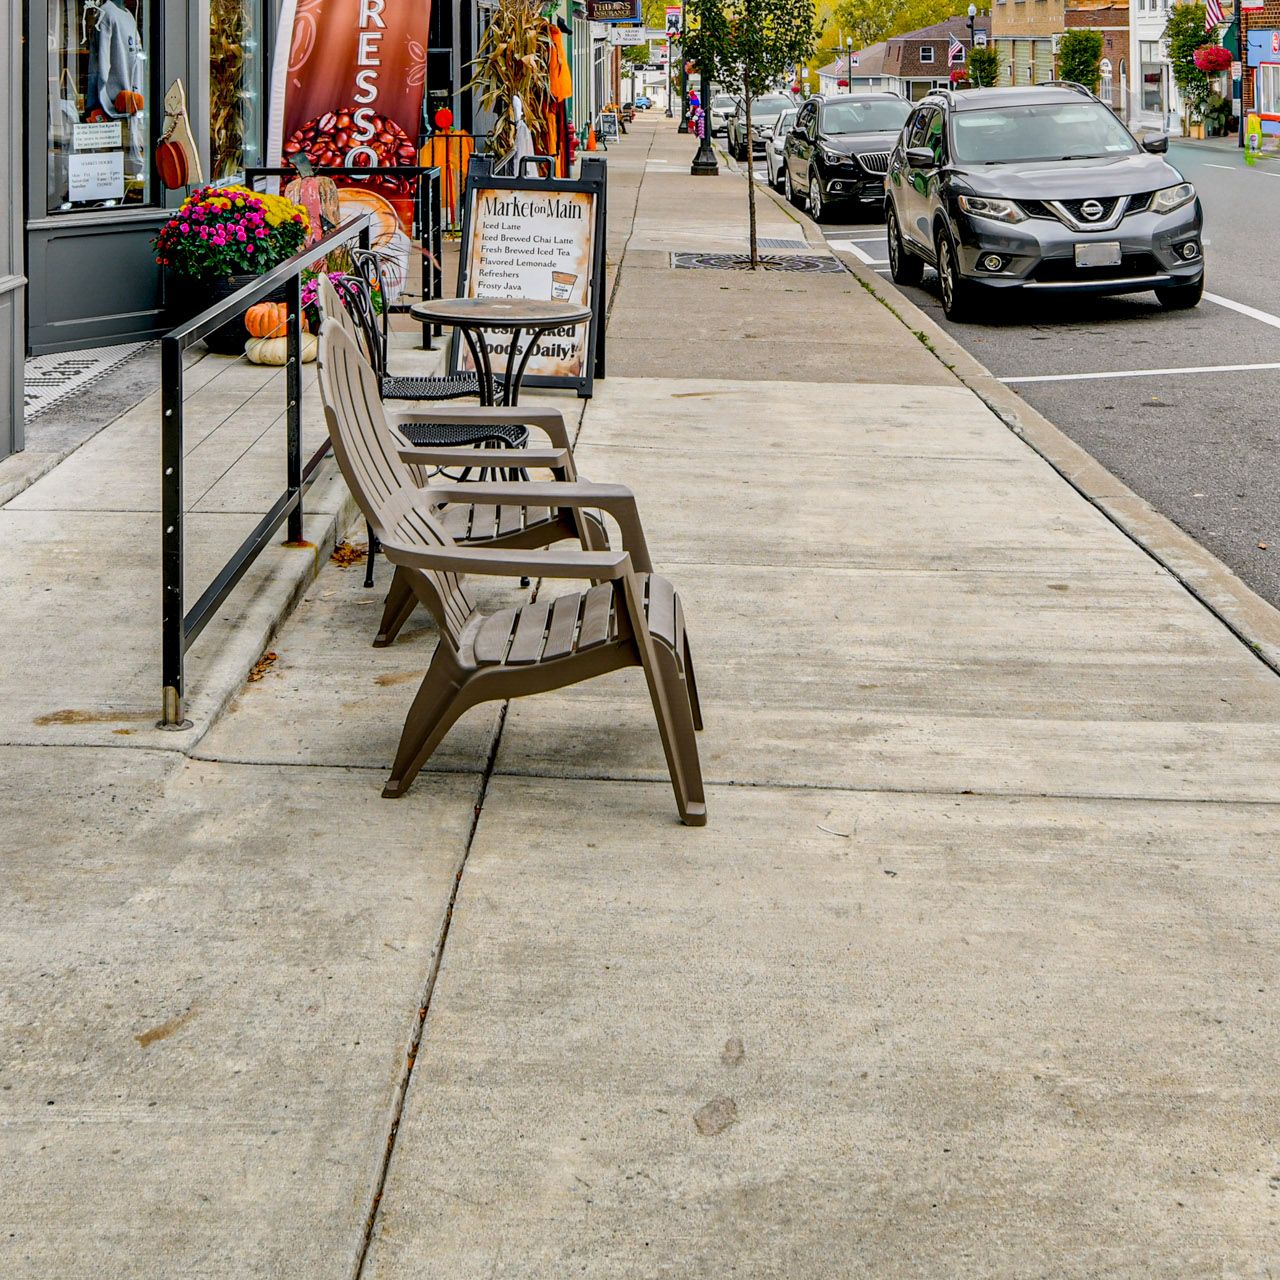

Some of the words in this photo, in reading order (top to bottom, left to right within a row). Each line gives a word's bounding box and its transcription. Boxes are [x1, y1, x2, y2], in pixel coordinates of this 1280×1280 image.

[484, 196, 534, 217] Market
[534, 205, 546, 214] on
[546, 199, 582, 219] Main
[502, 222, 521, 230] Latte
[500, 235, 531, 243] Brewed
[533, 236, 551, 244] Chai
[554, 236, 573, 245] Latte
[481, 245, 502, 253] Fresh
[505, 246, 535, 255] Brewed
[537, 248, 554, 256] Iced
[480, 257, 514, 266] Flavored
[516, 259, 557, 268] Lemonade
[479, 269, 519, 278] Refreshers
[477, 281, 501, 290] Frosty
